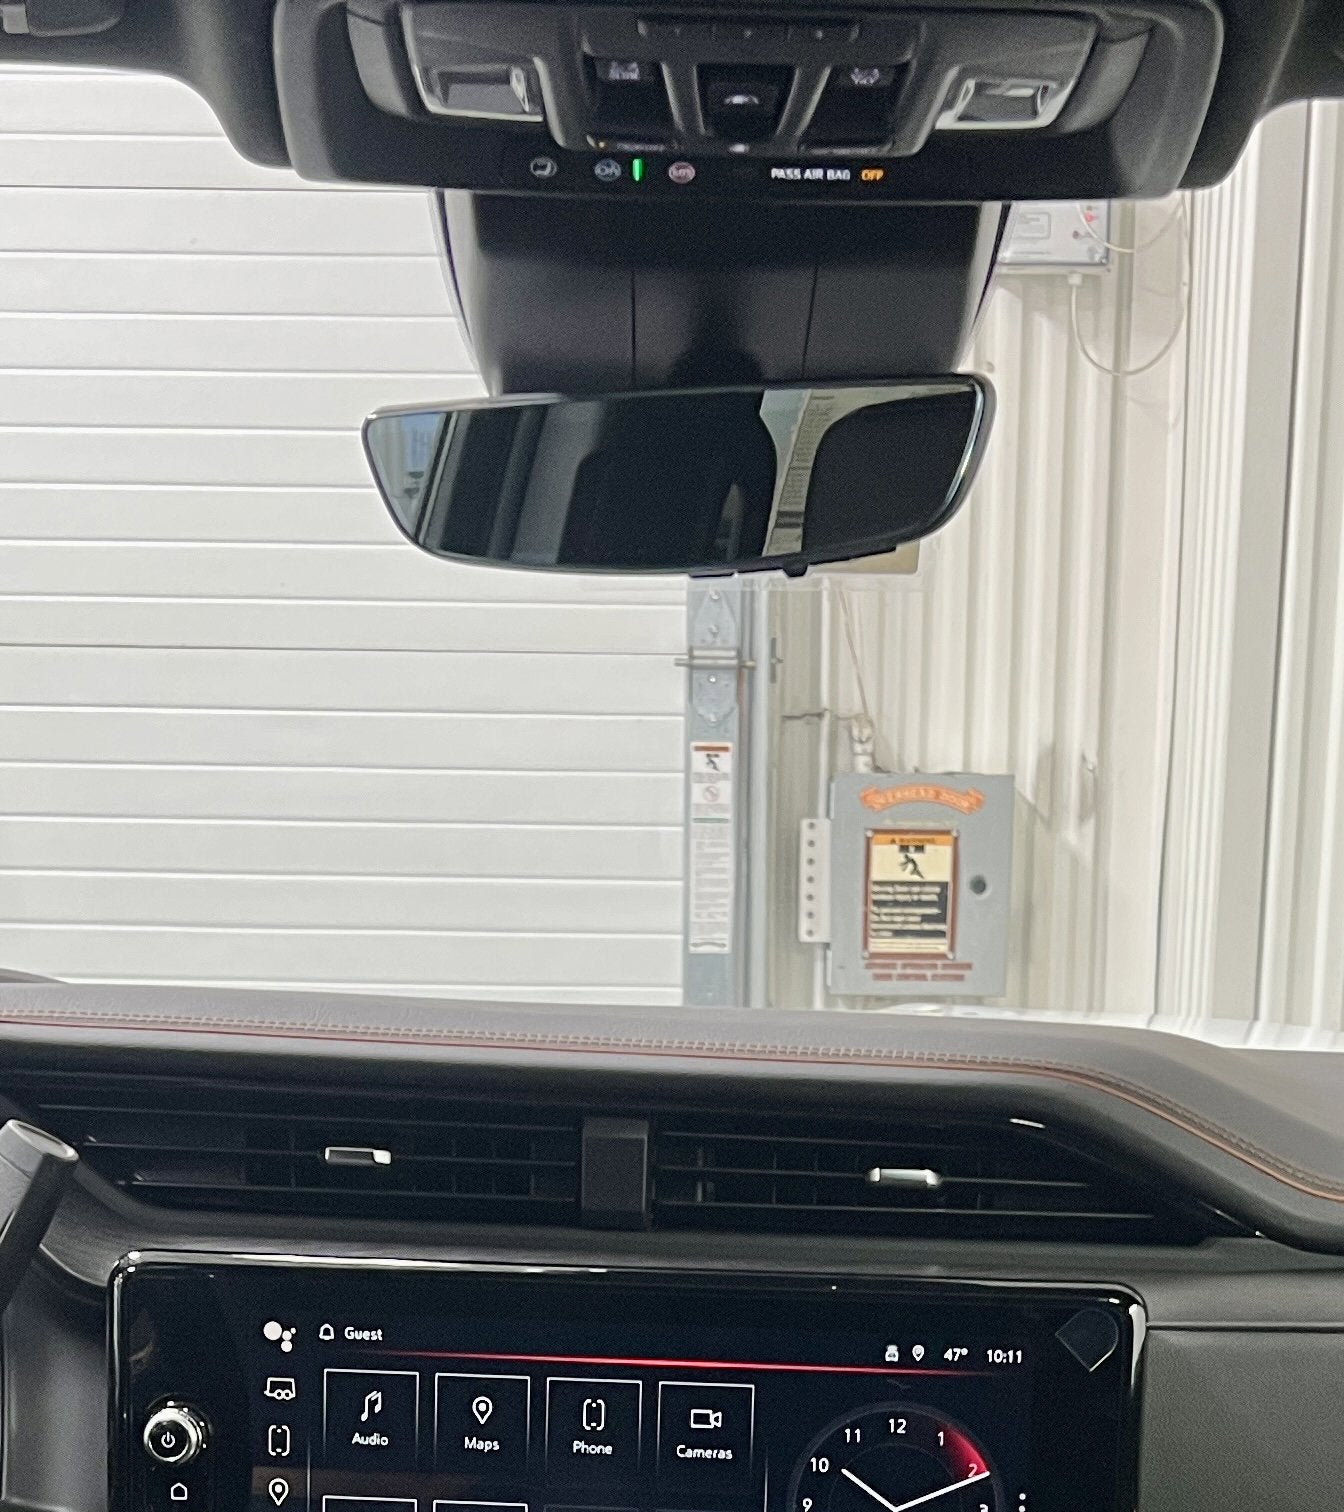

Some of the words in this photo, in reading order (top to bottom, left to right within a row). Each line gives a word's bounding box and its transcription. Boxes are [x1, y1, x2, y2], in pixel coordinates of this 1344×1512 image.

[771, 167, 801, 181] PASS
[803, 168, 824, 181] AIR
[826, 168, 851, 181] BAG
[860, 168, 884, 181] OFF
[344, 1327, 383, 1341] Guest
[987, 1349, 1022, 1363] 10:11
[888, 1418, 907, 1433] 12
[352, 1433, 389, 1446] Audio
[845, 1428, 861, 1443] 11
[937, 1432, 944, 1446] 1
[464, 1437, 500, 1452] Maps
[573, 1440, 613, 1455] Phone
[676, 1444, 733, 1460] Cameras
[810, 1457, 830, 1473] 10
[968, 1464, 978, 1478] 2
[802, 1497, 813, 1512] 9
